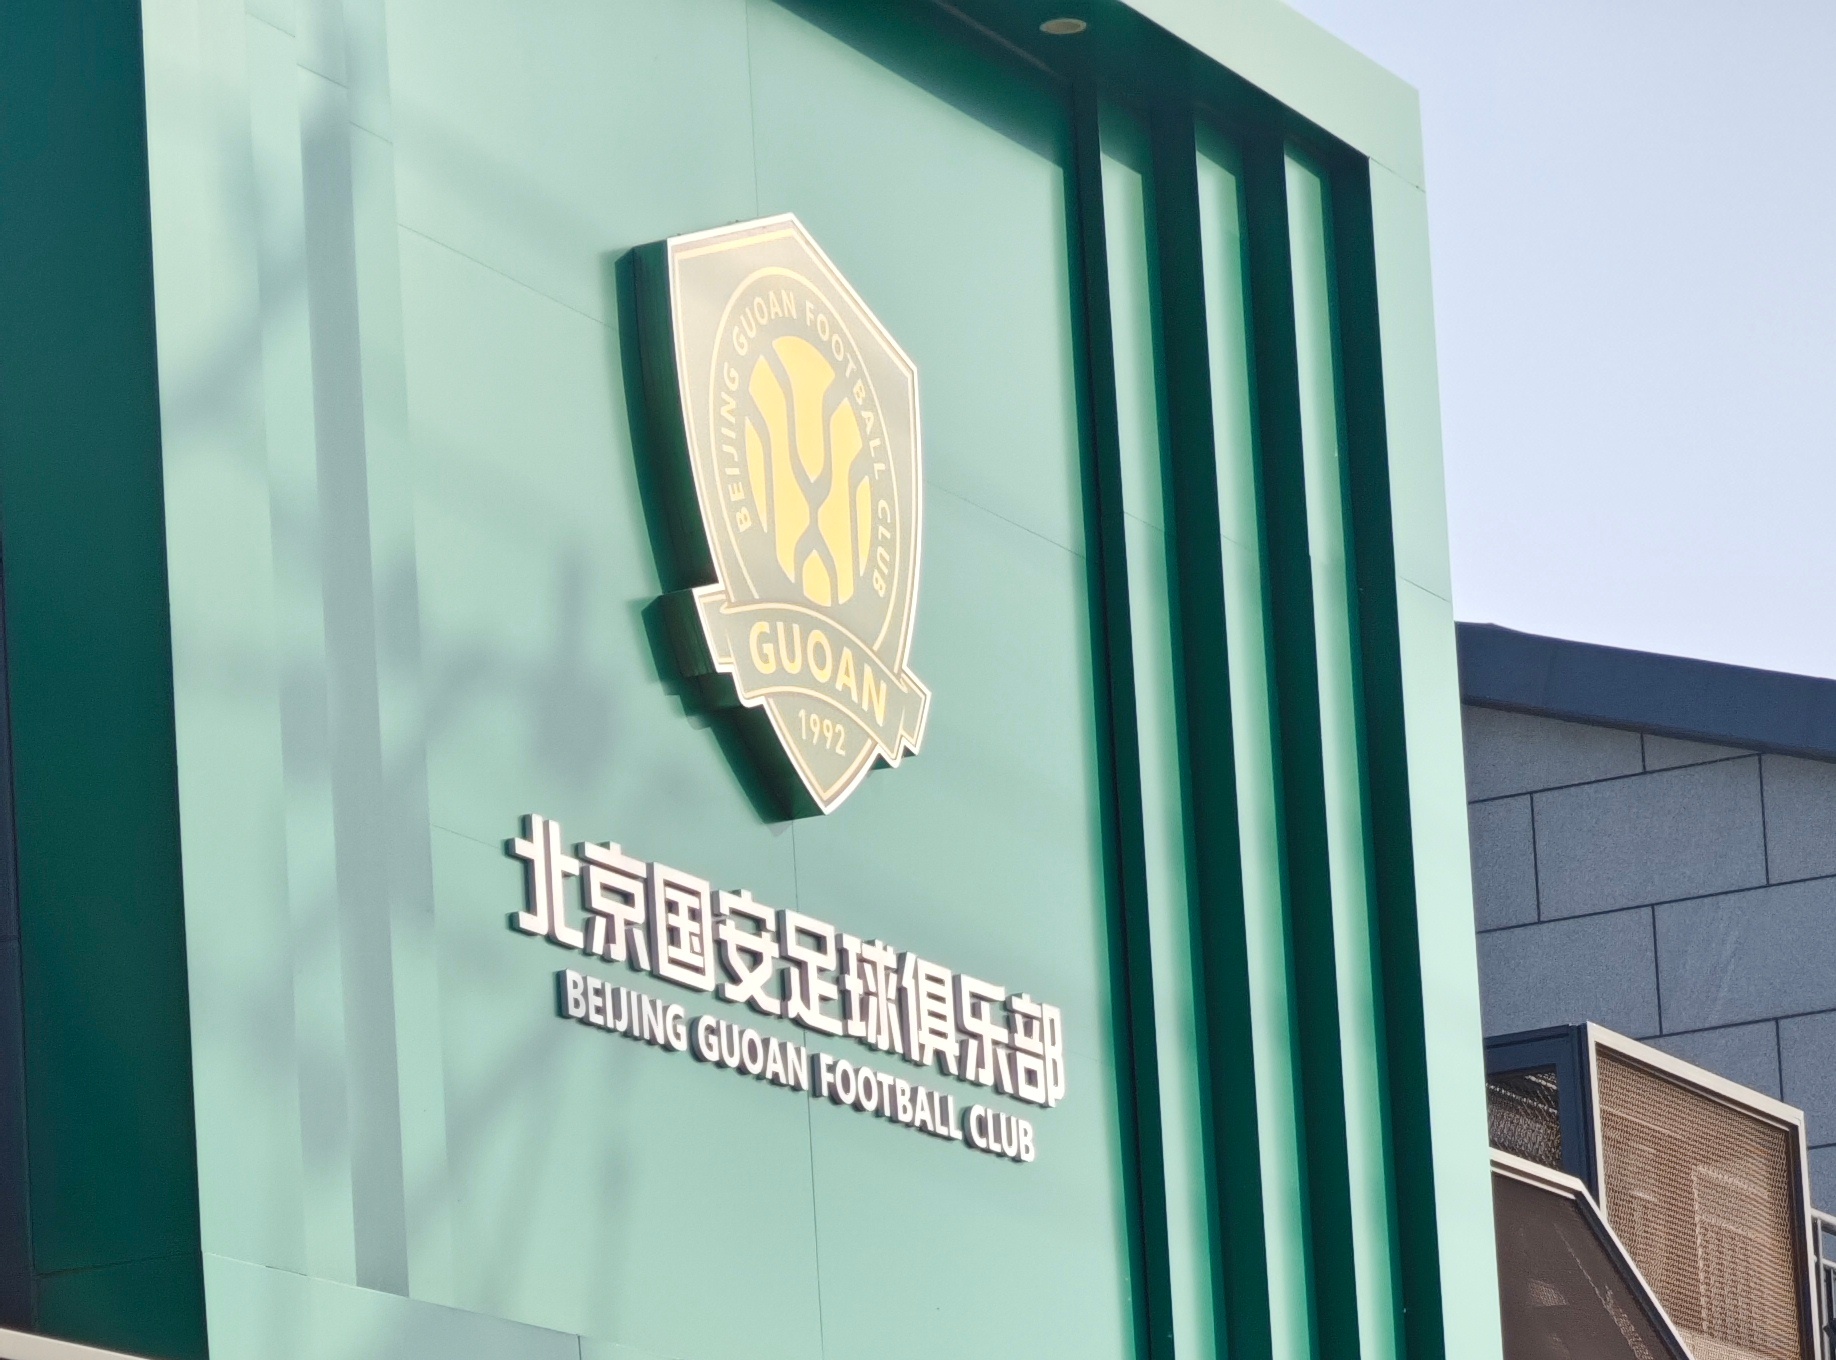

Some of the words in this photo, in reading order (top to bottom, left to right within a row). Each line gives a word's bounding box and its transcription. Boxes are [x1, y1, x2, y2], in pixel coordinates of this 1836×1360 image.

[732, 289, 797, 356] GUOAN
[805, 300, 886, 480] FOOTBALL
[721, 362, 752, 532] BEIJING
[872, 499, 890, 598] CLUB
[749, 620, 887, 727] GUOAN
[798, 708, 846, 757] 1992
[505, 813, 1066, 1107] 北京国安足球俱乐部
[561, 968, 688, 1051] BEIJING
[695, 1014, 809, 1091] GUOAN
[815, 1052, 963, 1140] FOOTBALL
[966, 1104, 1035, 1162] CLUB
